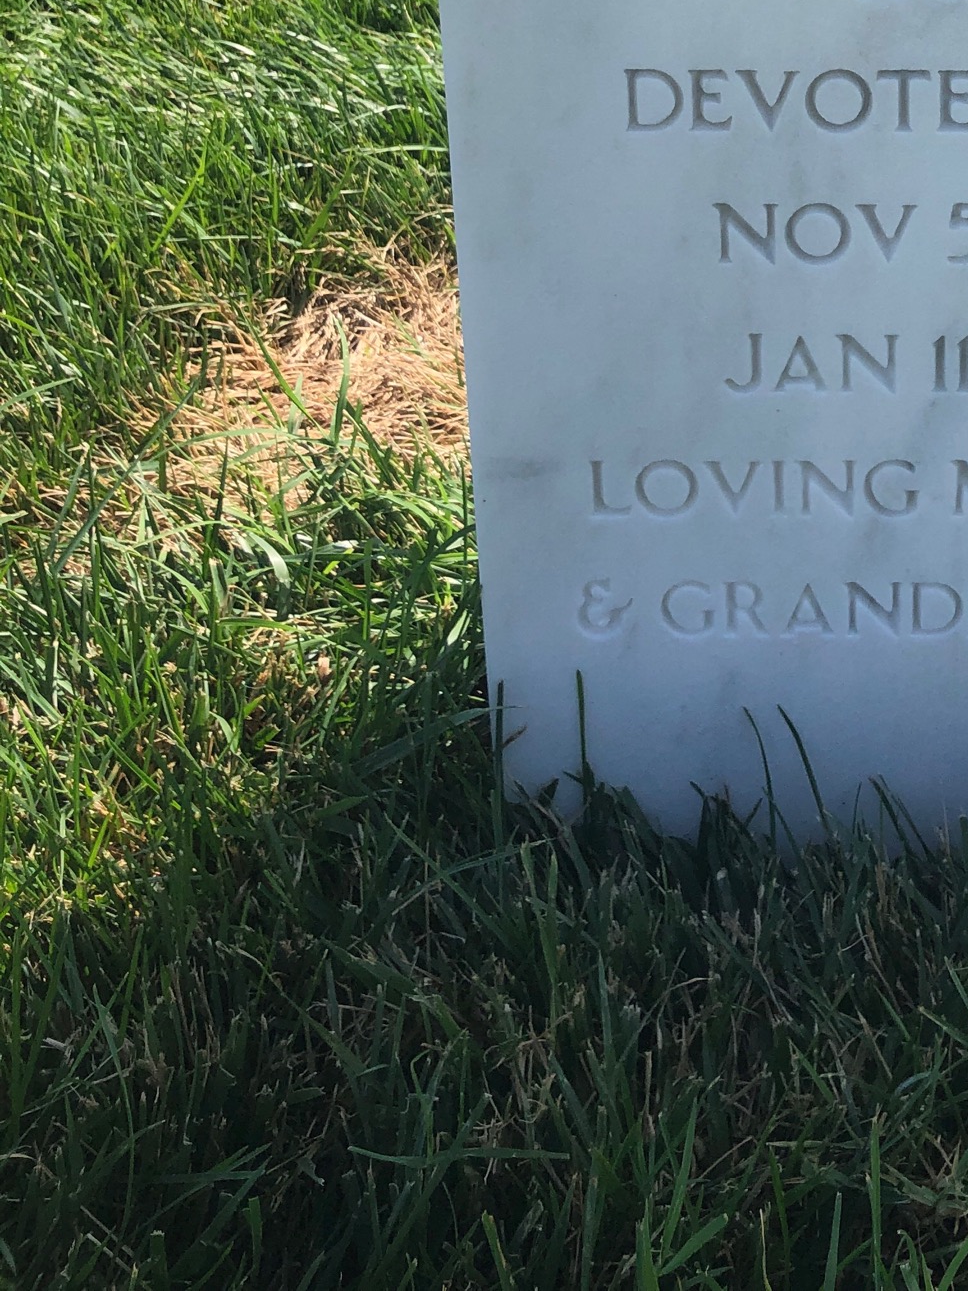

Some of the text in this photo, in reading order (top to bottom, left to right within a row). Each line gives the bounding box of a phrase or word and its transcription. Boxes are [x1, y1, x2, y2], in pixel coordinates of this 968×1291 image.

[712, 202, 918, 266] NOV
[724, 332, 899, 394] JAN
[588, 459, 920, 517] LOVING
[577, 578, 634, 638] &
